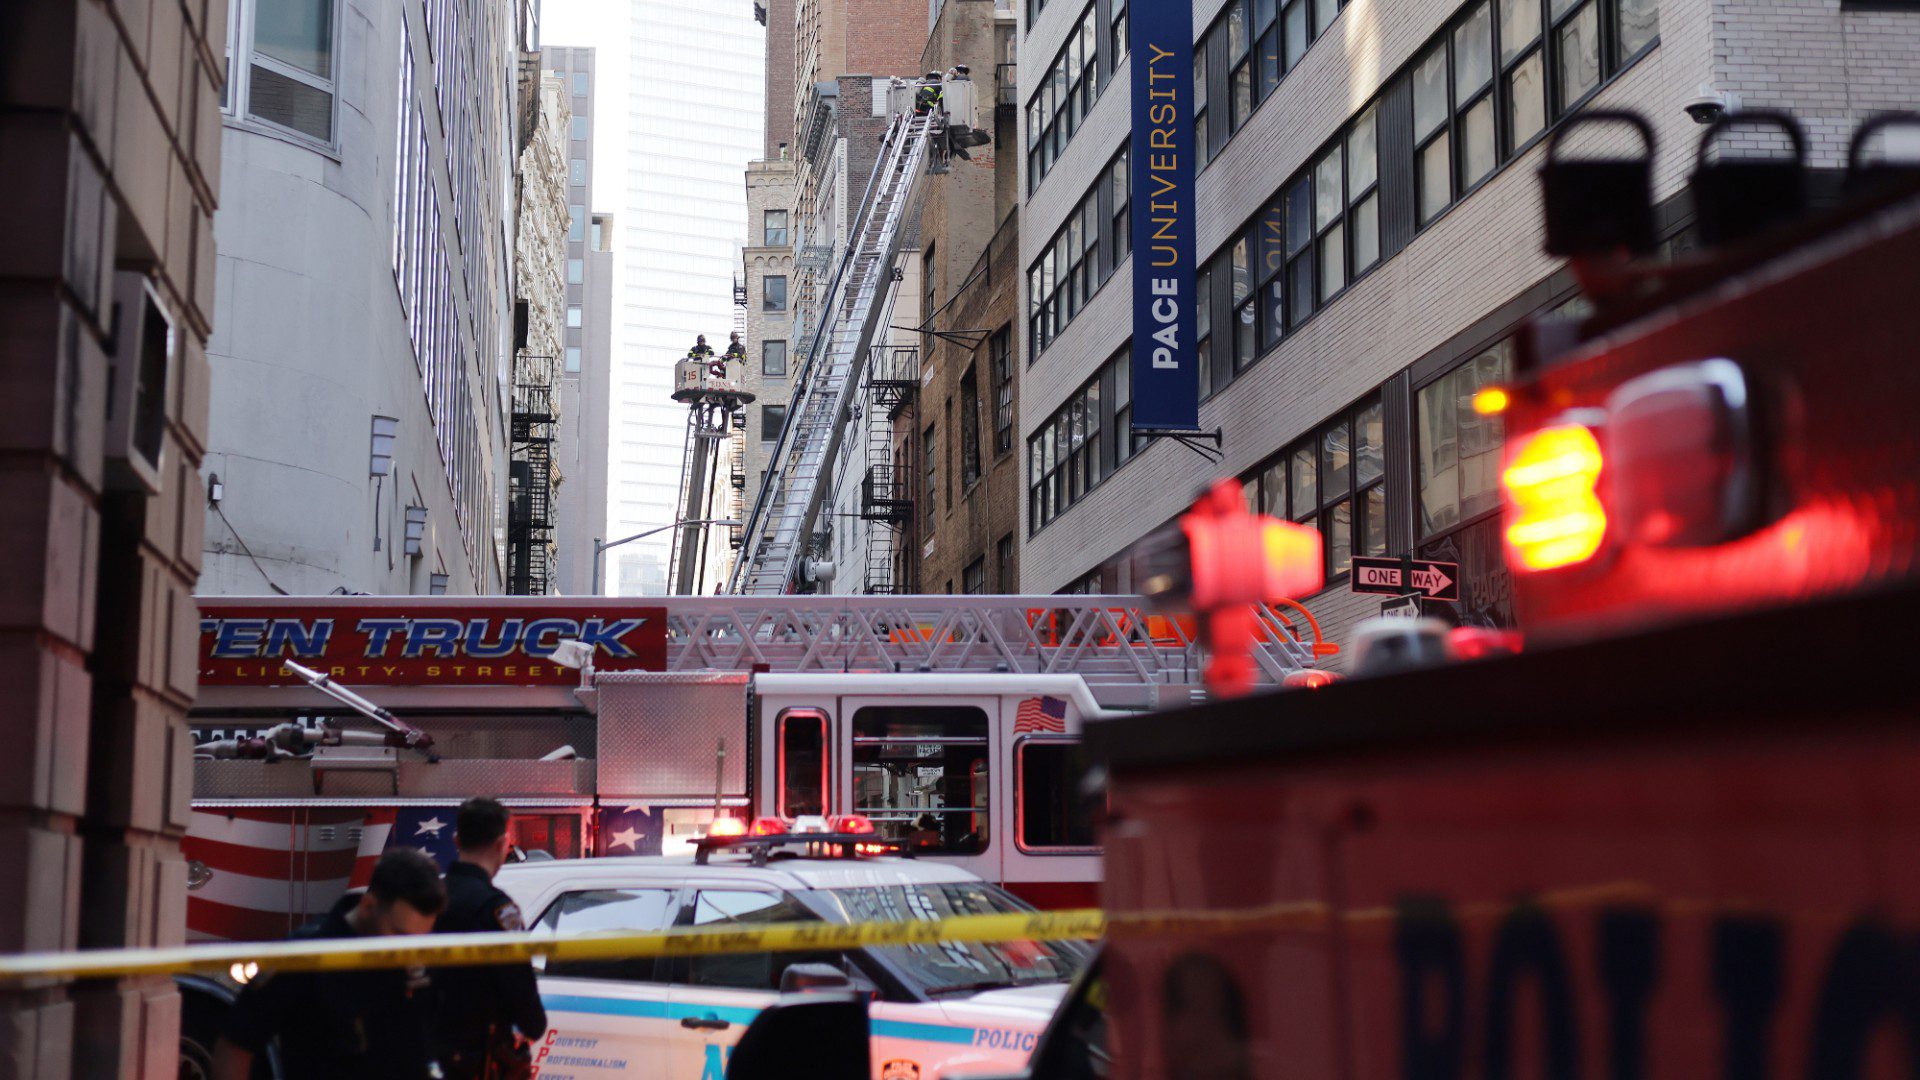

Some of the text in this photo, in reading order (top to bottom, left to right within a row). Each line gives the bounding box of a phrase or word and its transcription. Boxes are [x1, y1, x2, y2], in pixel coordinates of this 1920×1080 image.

[1149, 43, 1178, 368] PACE UNIVERSITY
[688, 370, 697, 380] 15
[1367, 569, 1443, 588] ONE WAY
[356, 618, 648, 658] TRUCK
[236, 666, 566, 677] LIBRTY STREET
[545, 1029, 598, 1049] COURTESY
[976, 1028, 1042, 1051] POLIC
